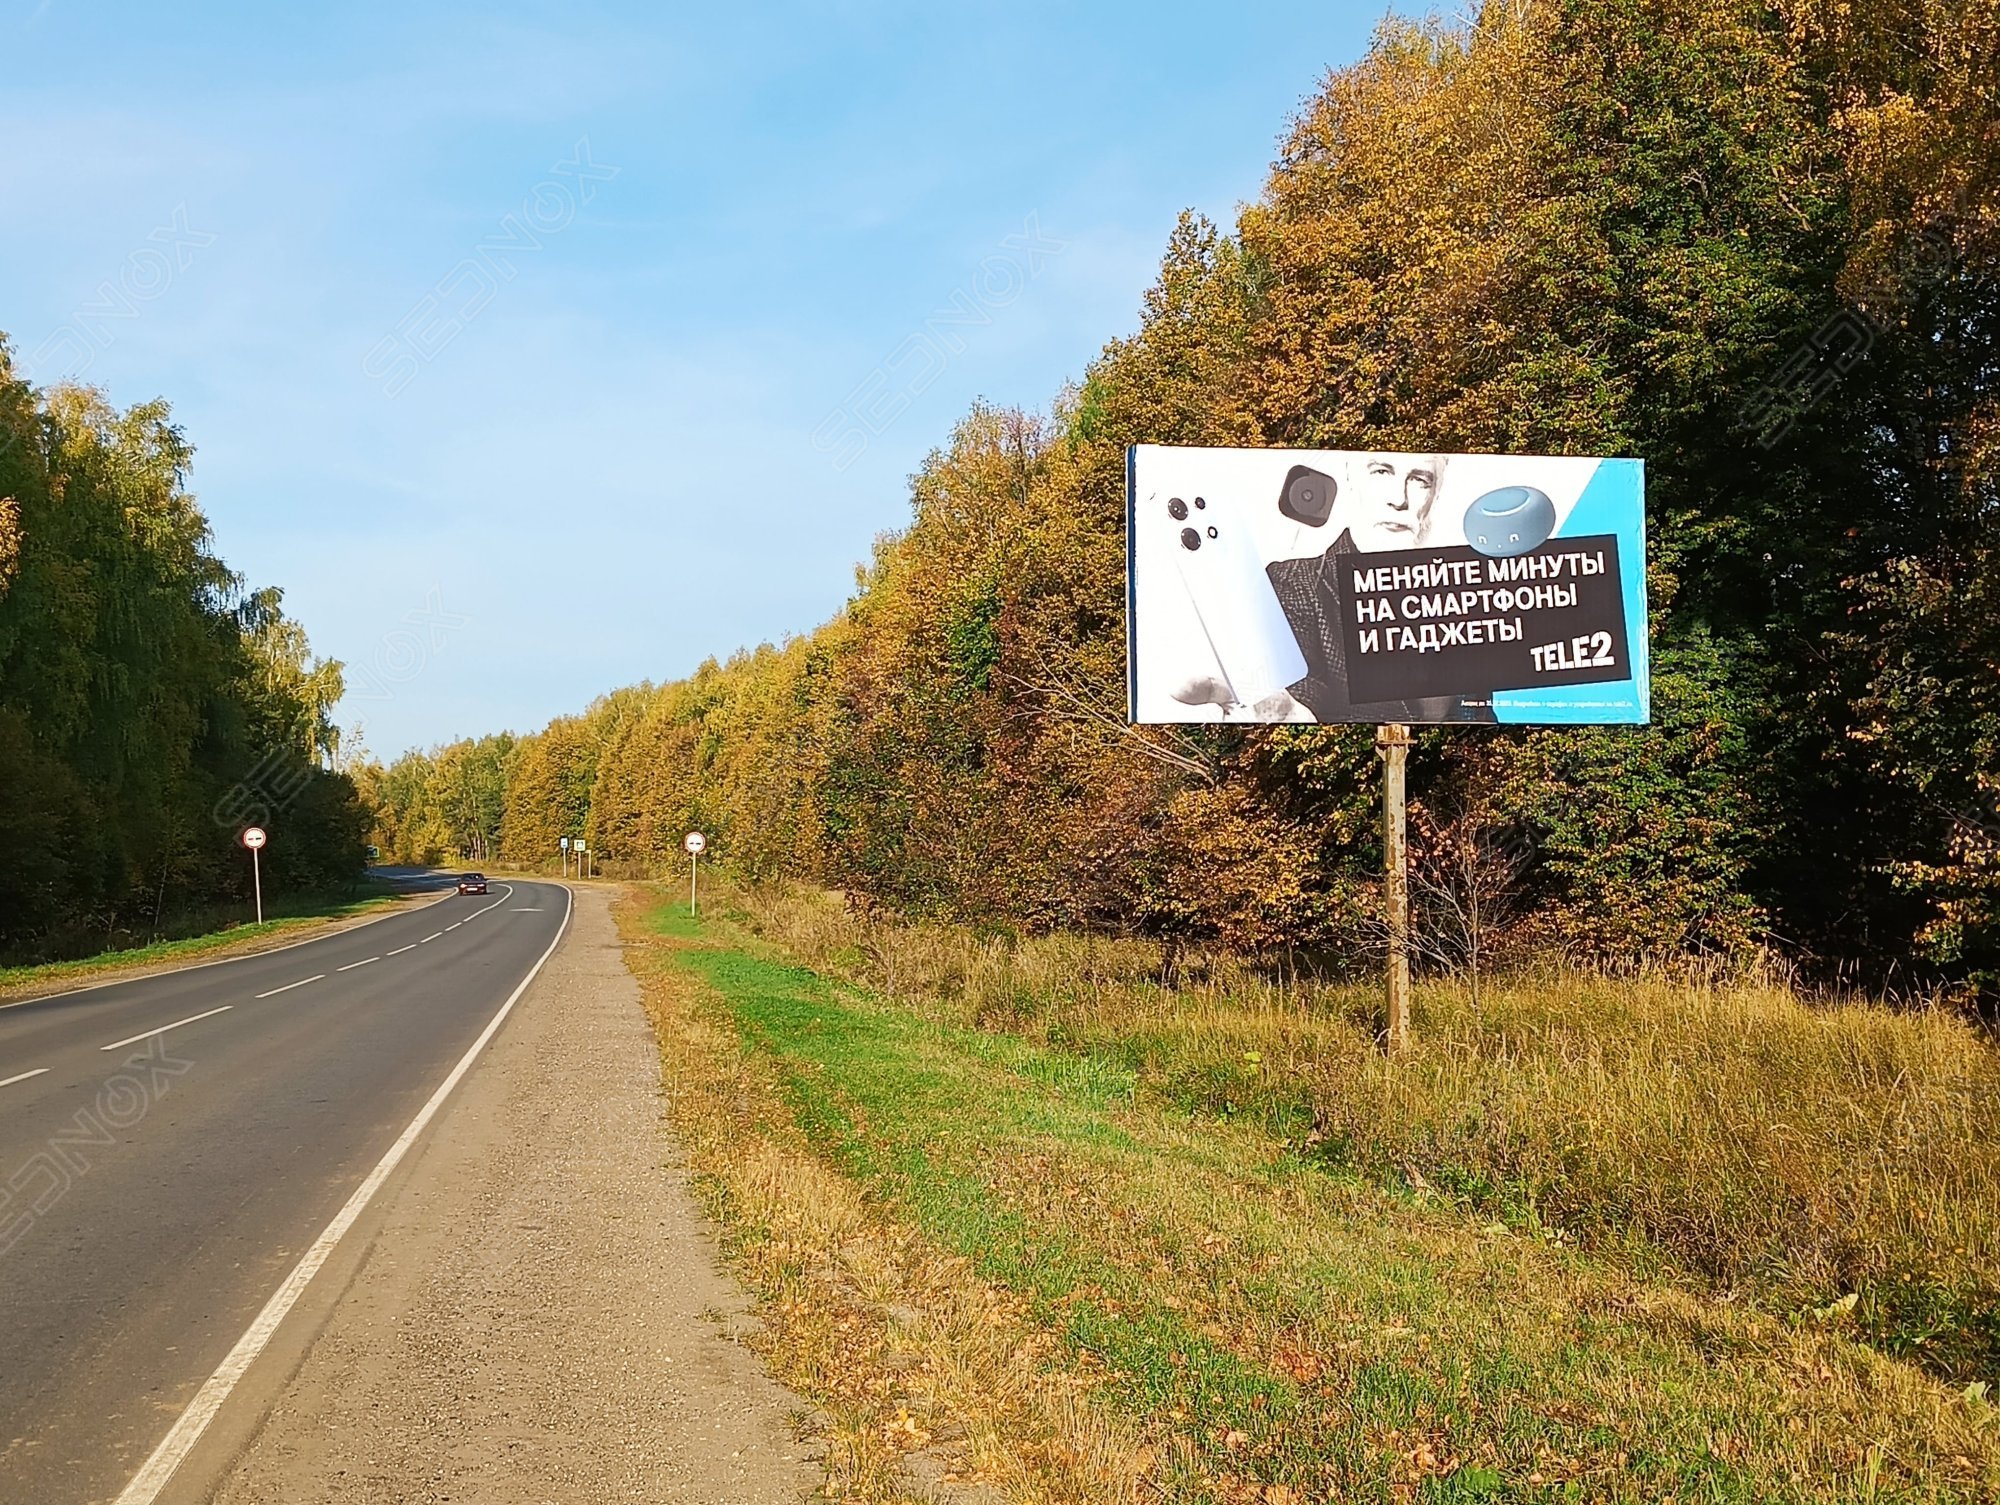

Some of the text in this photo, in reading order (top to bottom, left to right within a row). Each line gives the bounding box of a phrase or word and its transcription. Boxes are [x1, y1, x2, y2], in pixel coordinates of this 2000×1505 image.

[1354, 551, 1605, 593] МЕНЯЙТЕ МИНУТЫ
[1356, 583, 1578, 623] НА СМАРТФОНЫ
[1359, 617, 1523, 653] И ГАДЖЕТЫ
[1530, 631, 1615, 672] TELE2
